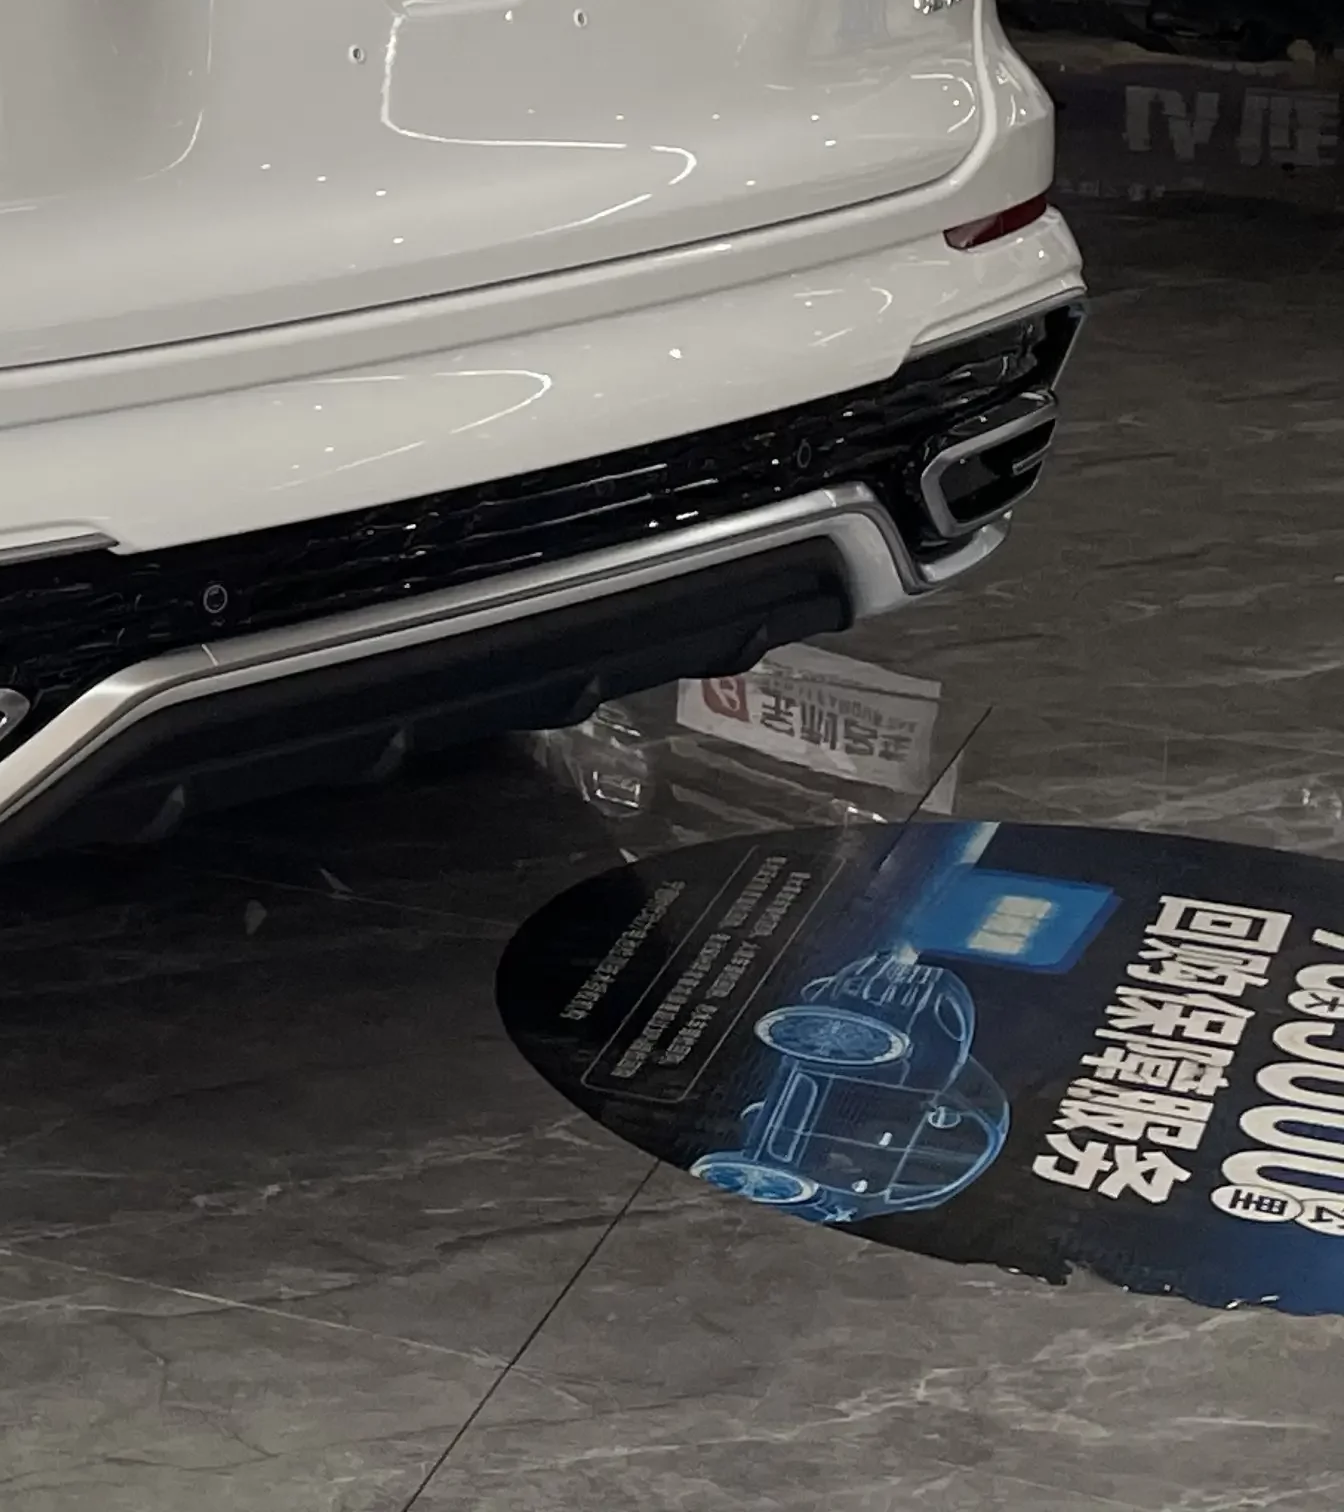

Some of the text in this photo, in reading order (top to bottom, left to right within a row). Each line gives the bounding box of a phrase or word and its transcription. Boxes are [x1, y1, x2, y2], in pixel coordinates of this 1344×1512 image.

[1032, 895, 1292, 1204] 回购保障服务
